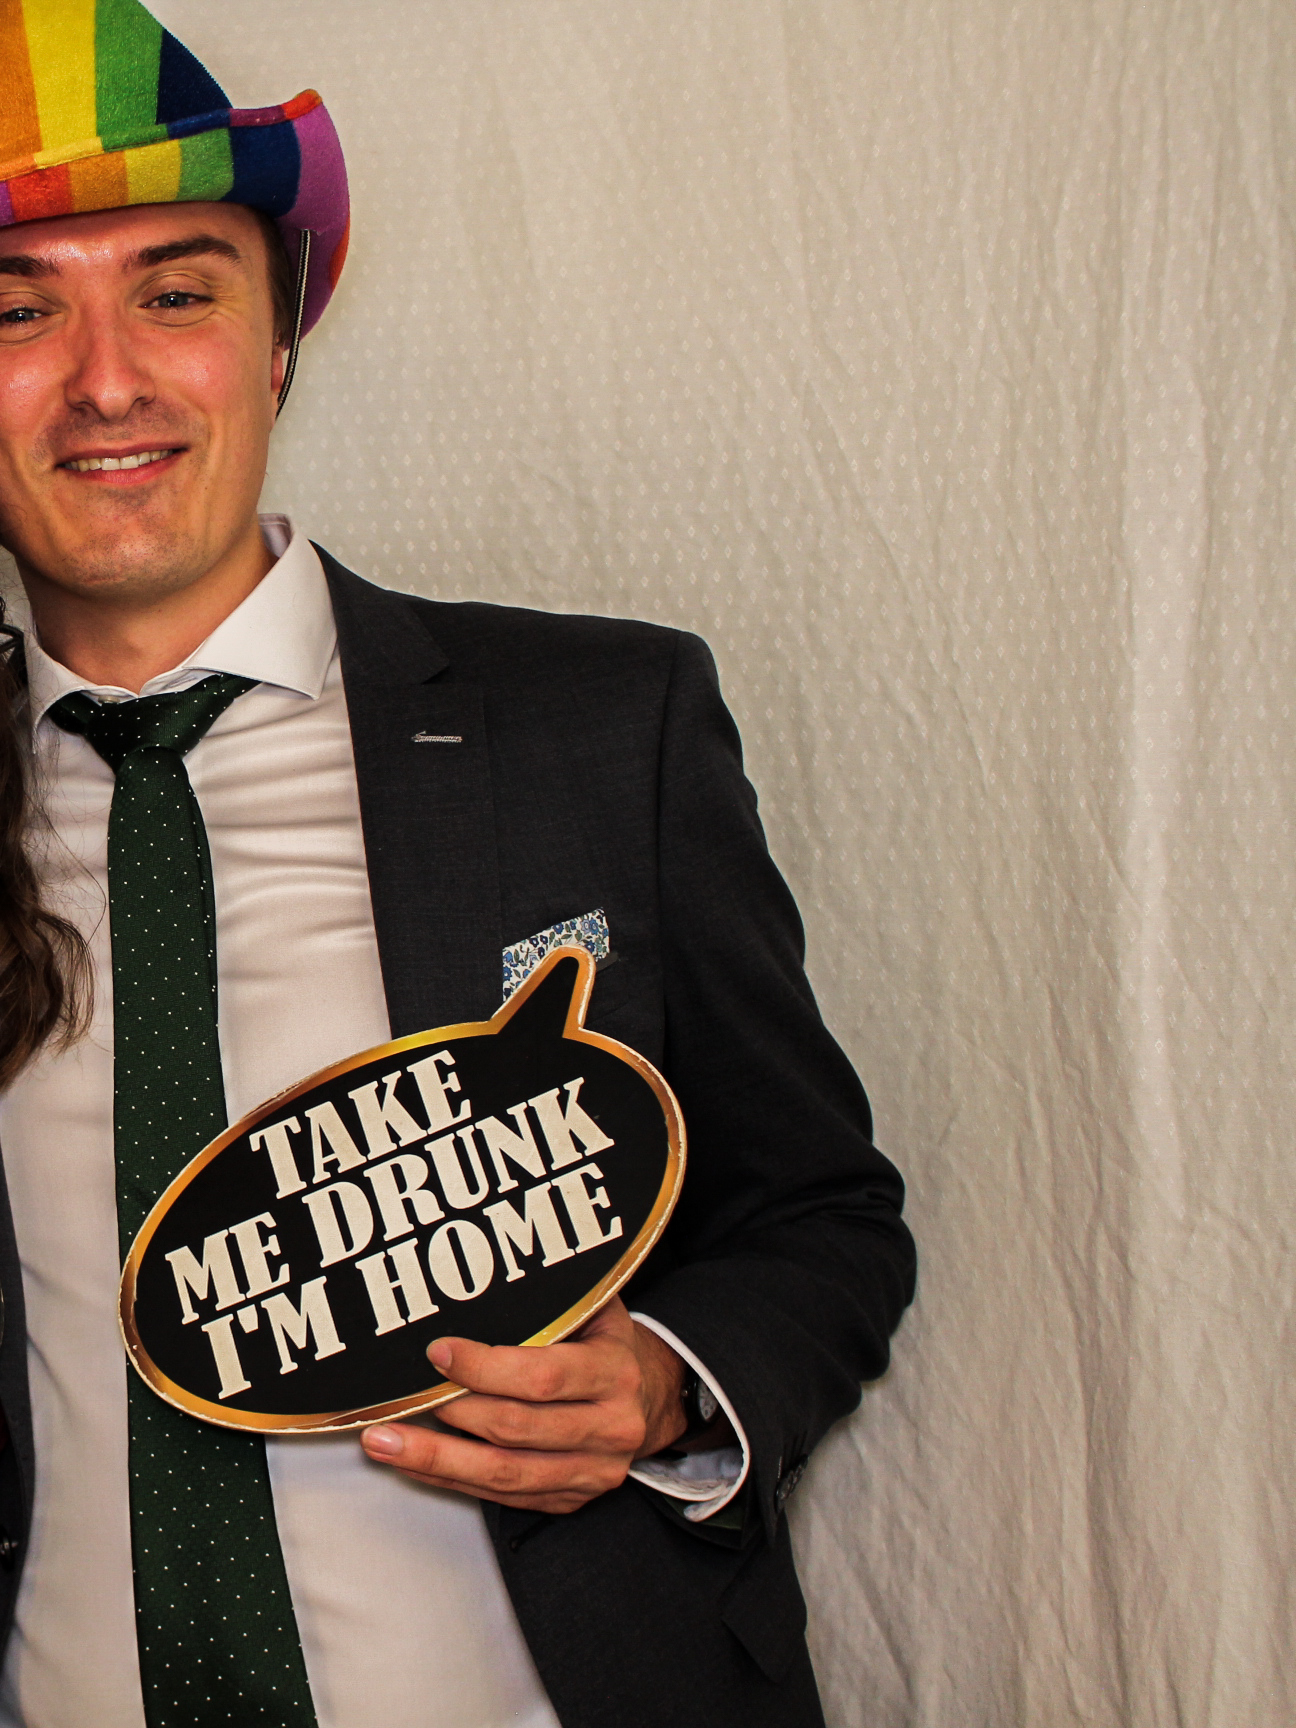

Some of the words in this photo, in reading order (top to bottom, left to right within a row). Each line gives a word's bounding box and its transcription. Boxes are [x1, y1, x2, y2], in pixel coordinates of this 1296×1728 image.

[164, 1211, 291, 1326] ME
[302, 1076, 615, 1268] DRUNK
[249, 1049, 472, 1200] TAKE
[201, 1275, 347, 1400] I'M
[355, 1162, 623, 1336] HOME
